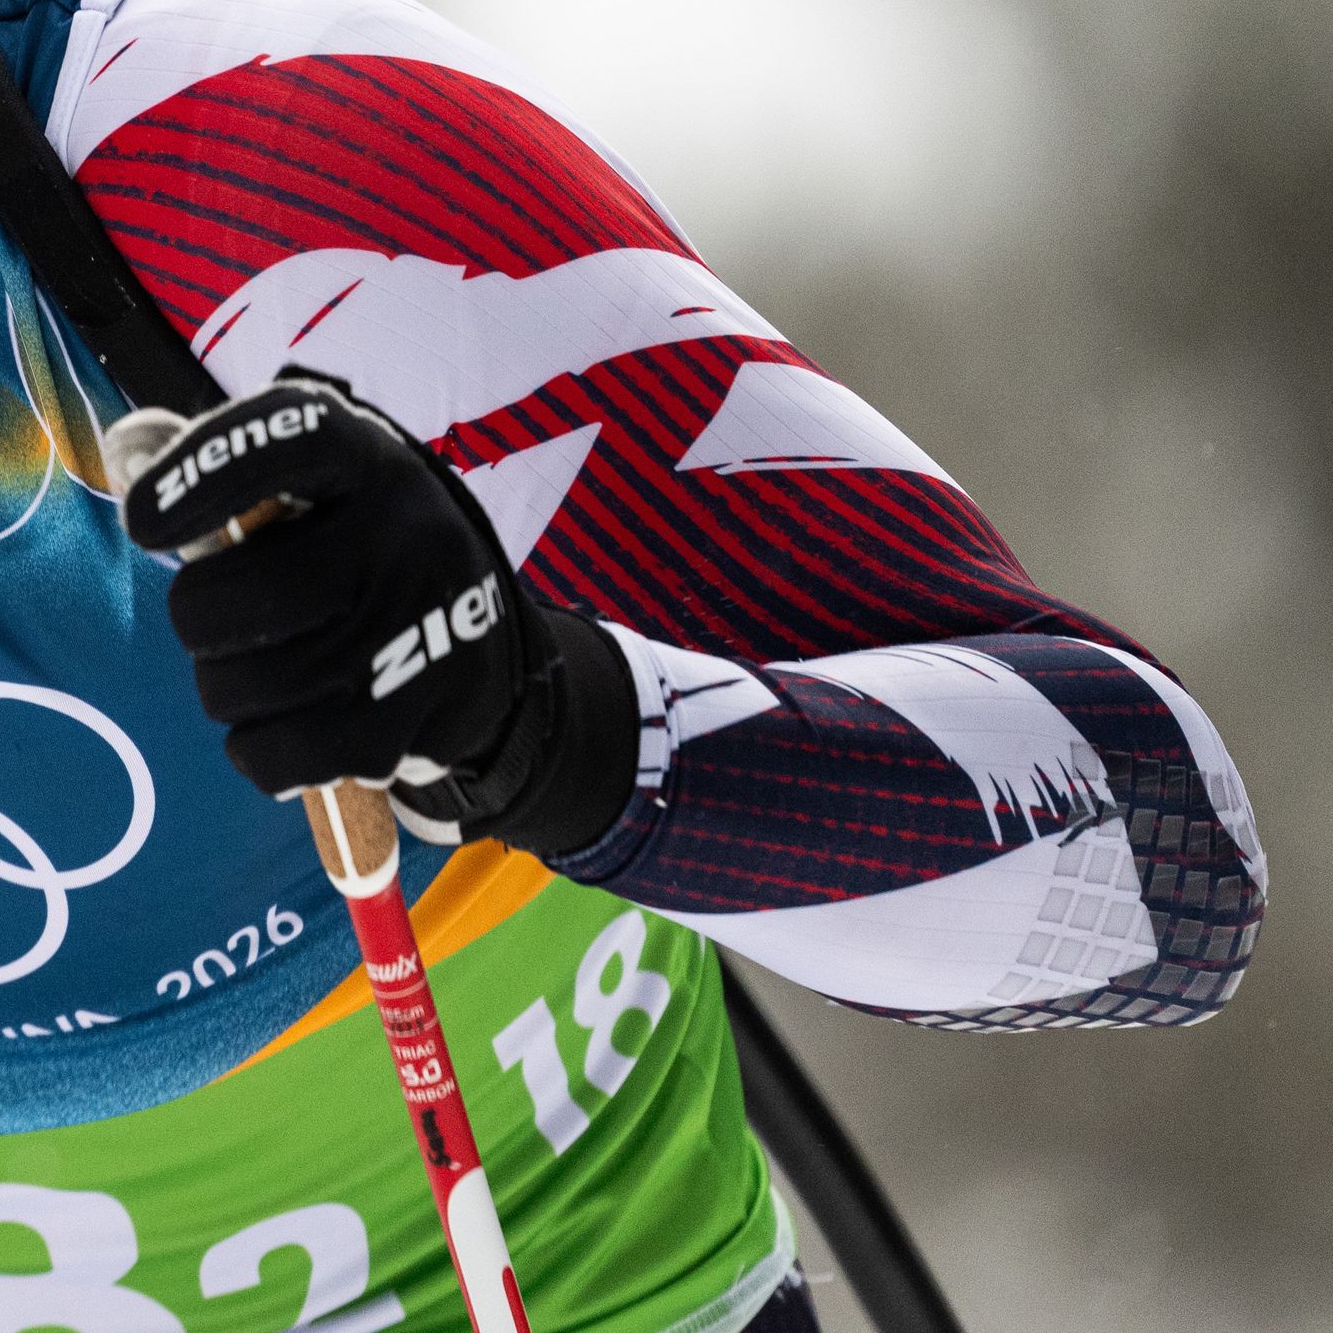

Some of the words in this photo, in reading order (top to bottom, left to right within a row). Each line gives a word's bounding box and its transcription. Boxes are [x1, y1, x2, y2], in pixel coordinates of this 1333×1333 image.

[155, 401, 328, 513] ziener
[156, 903, 304, 1000] 2026
[492, 907, 671, 1157] 18
[200, 1203, 405, 1333] 2
